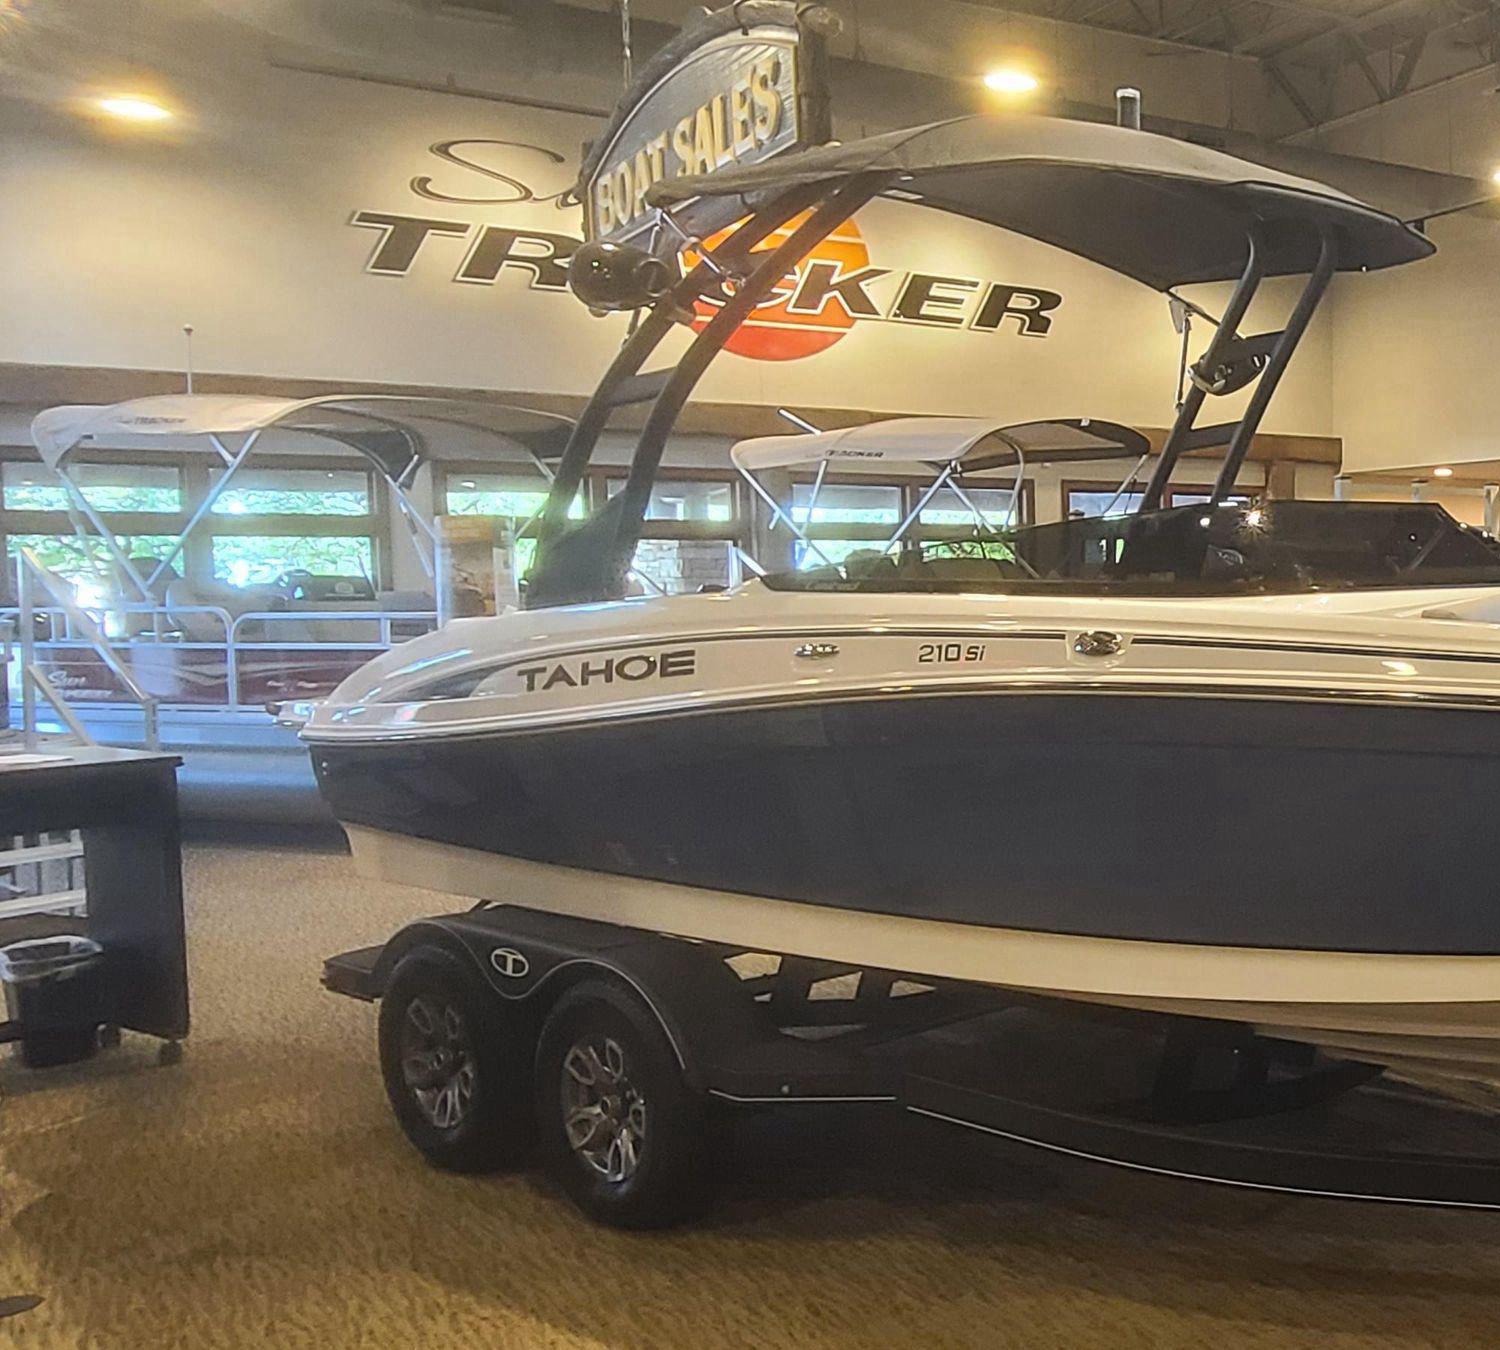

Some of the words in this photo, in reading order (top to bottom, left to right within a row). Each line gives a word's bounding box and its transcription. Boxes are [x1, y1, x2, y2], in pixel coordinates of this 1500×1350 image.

[597, 129, 671, 236] BOAT
[672, 54, 782, 177] SALES
[351, 211, 1062, 338] TRKER
[518, 650, 696, 692] TAHOE
[918, 644, 959, 664] 210
